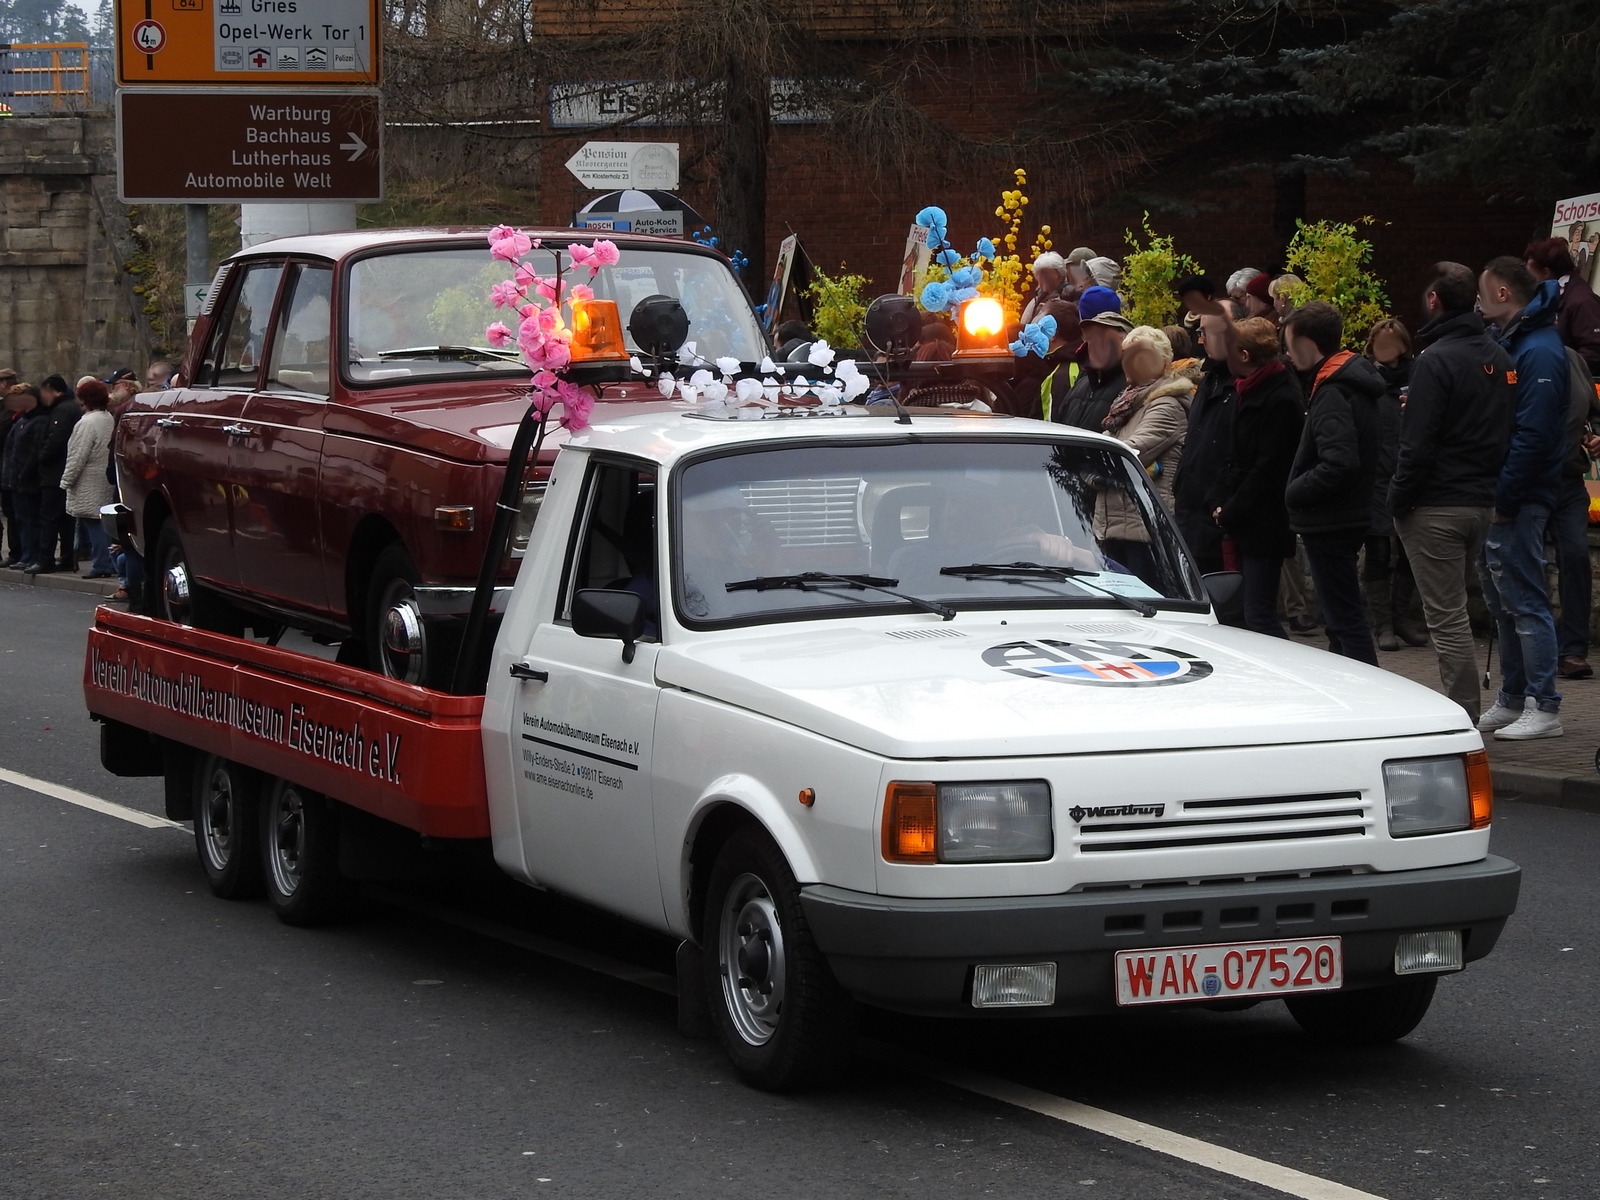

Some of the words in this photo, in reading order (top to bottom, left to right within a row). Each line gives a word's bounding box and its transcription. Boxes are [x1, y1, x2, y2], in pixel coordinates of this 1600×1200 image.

[251, 0, 297, 13] Gries
[219, 23, 313, 43] Opel-Werk
[322, 25, 350, 41] Tor
[358, 25, 366, 40] 1
[335, 54, 354, 62] Polizei
[250, 105, 331, 124] Wartburg
[246, 128, 331, 143] Bachhaus
[232, 150, 331, 166] Lutherhaus
[581, 148, 627, 160] Pension
[575, 160, 628, 169] Klostergarten
[185, 173, 285, 188] Automobile
[294, 173, 332, 188] Welt
[1554, 201, 1600, 223] Schors
[587, 222, 612, 230] BOSCH
[91, 646, 129, 696] Verein
[129, 658, 286, 745] Automobilbaumuseum
[288, 702, 363, 773] Eisenach
[368, 732, 402, 786] e.V.
[523, 712, 540, 728] Verein
[540, 717, 600, 745] Automobilbaumuseum
[601, 733, 628, 753] Eisenach
[628, 742, 640, 756] e.V.
[580, 765, 597, 783] 99817
[599, 771, 624, 790] Eisenach
[1087, 803, 1165, 818] Wartburg
